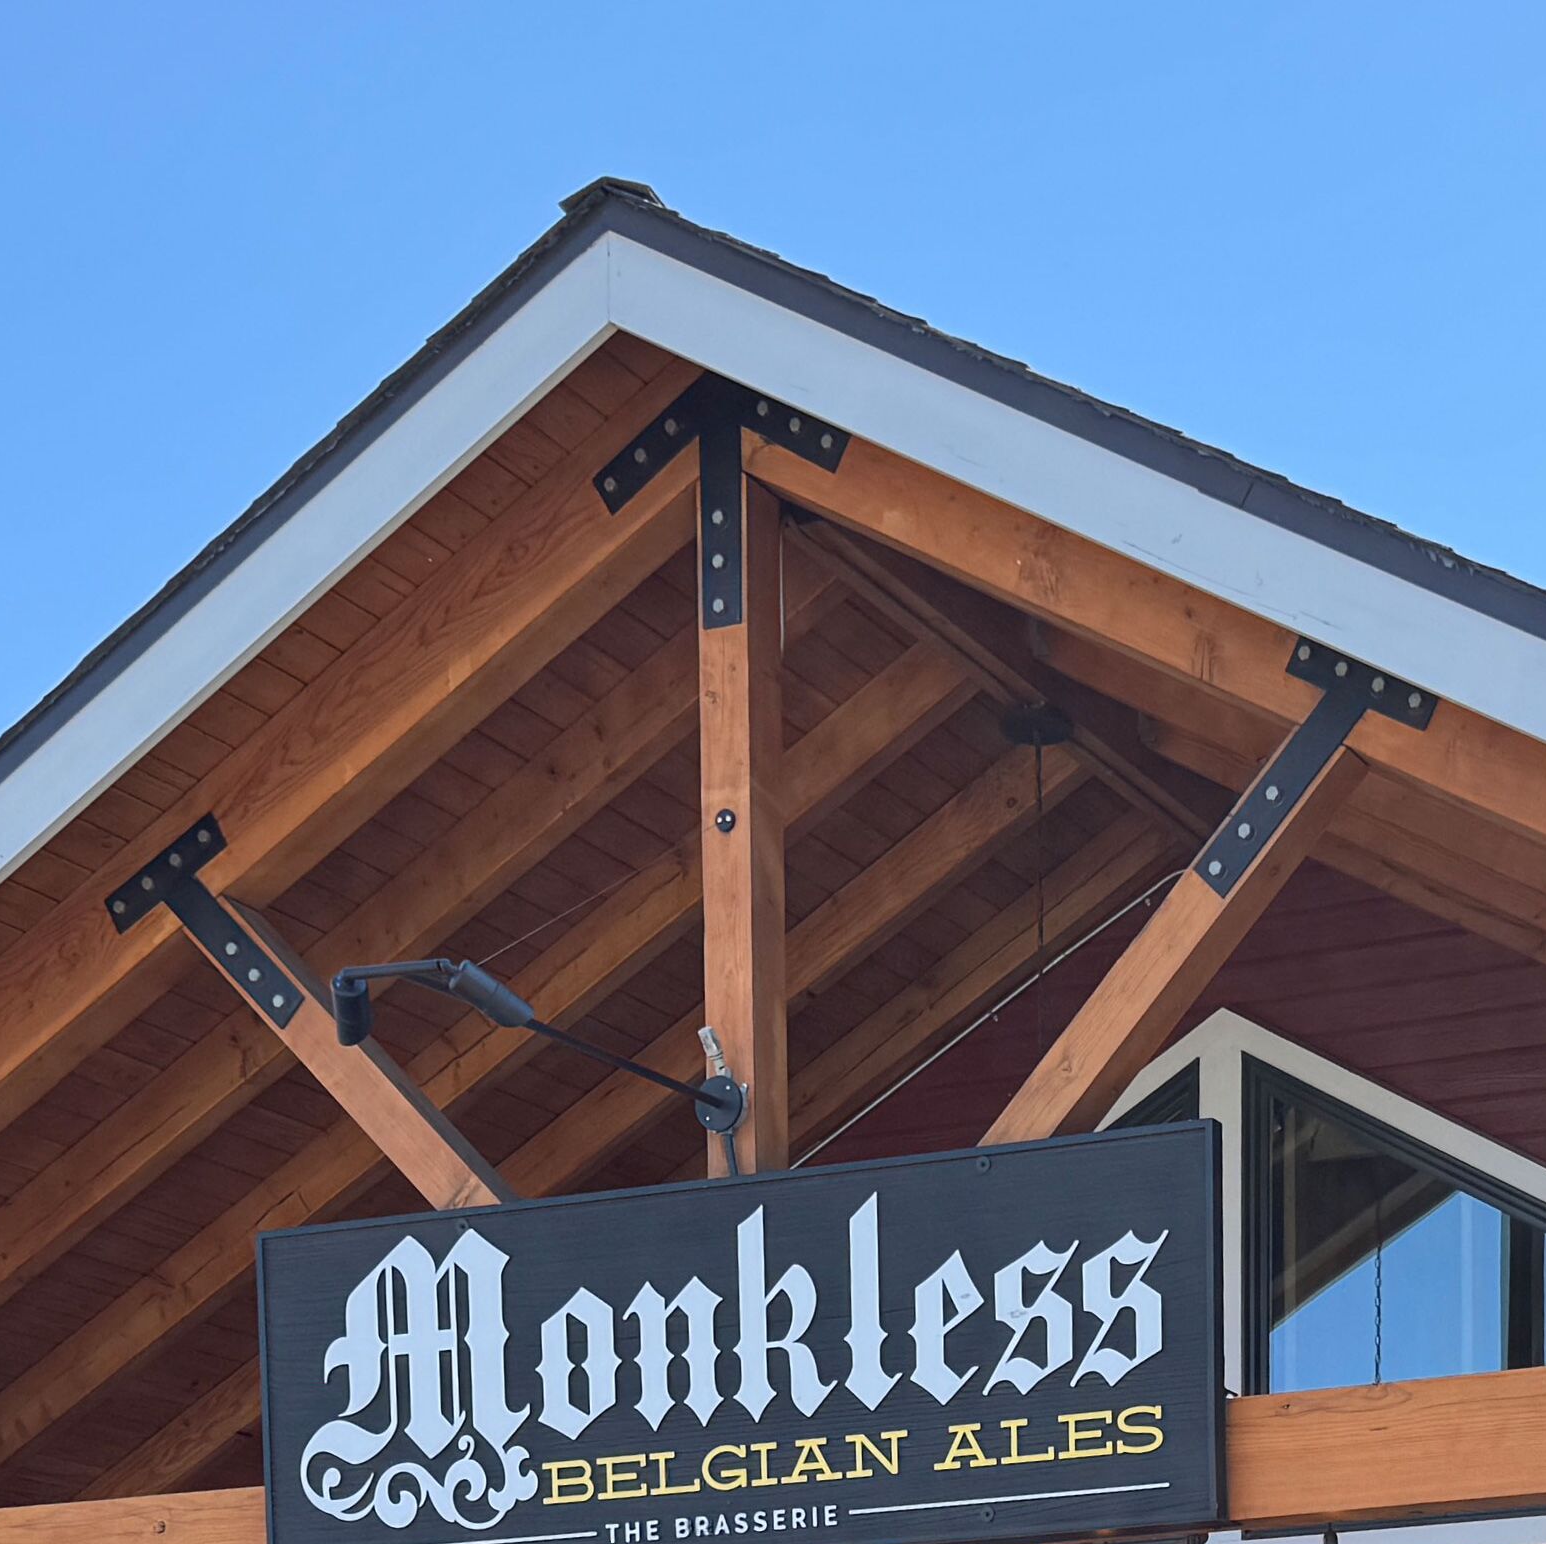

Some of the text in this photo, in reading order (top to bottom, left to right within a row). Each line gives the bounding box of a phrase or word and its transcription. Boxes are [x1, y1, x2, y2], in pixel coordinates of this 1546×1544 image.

[301, 1192, 1168, 1529] Monkless
[543, 1405, 1164, 1505] BELGIAN ALES
[604, 1505, 838, 1544] THE BRASSERIE
